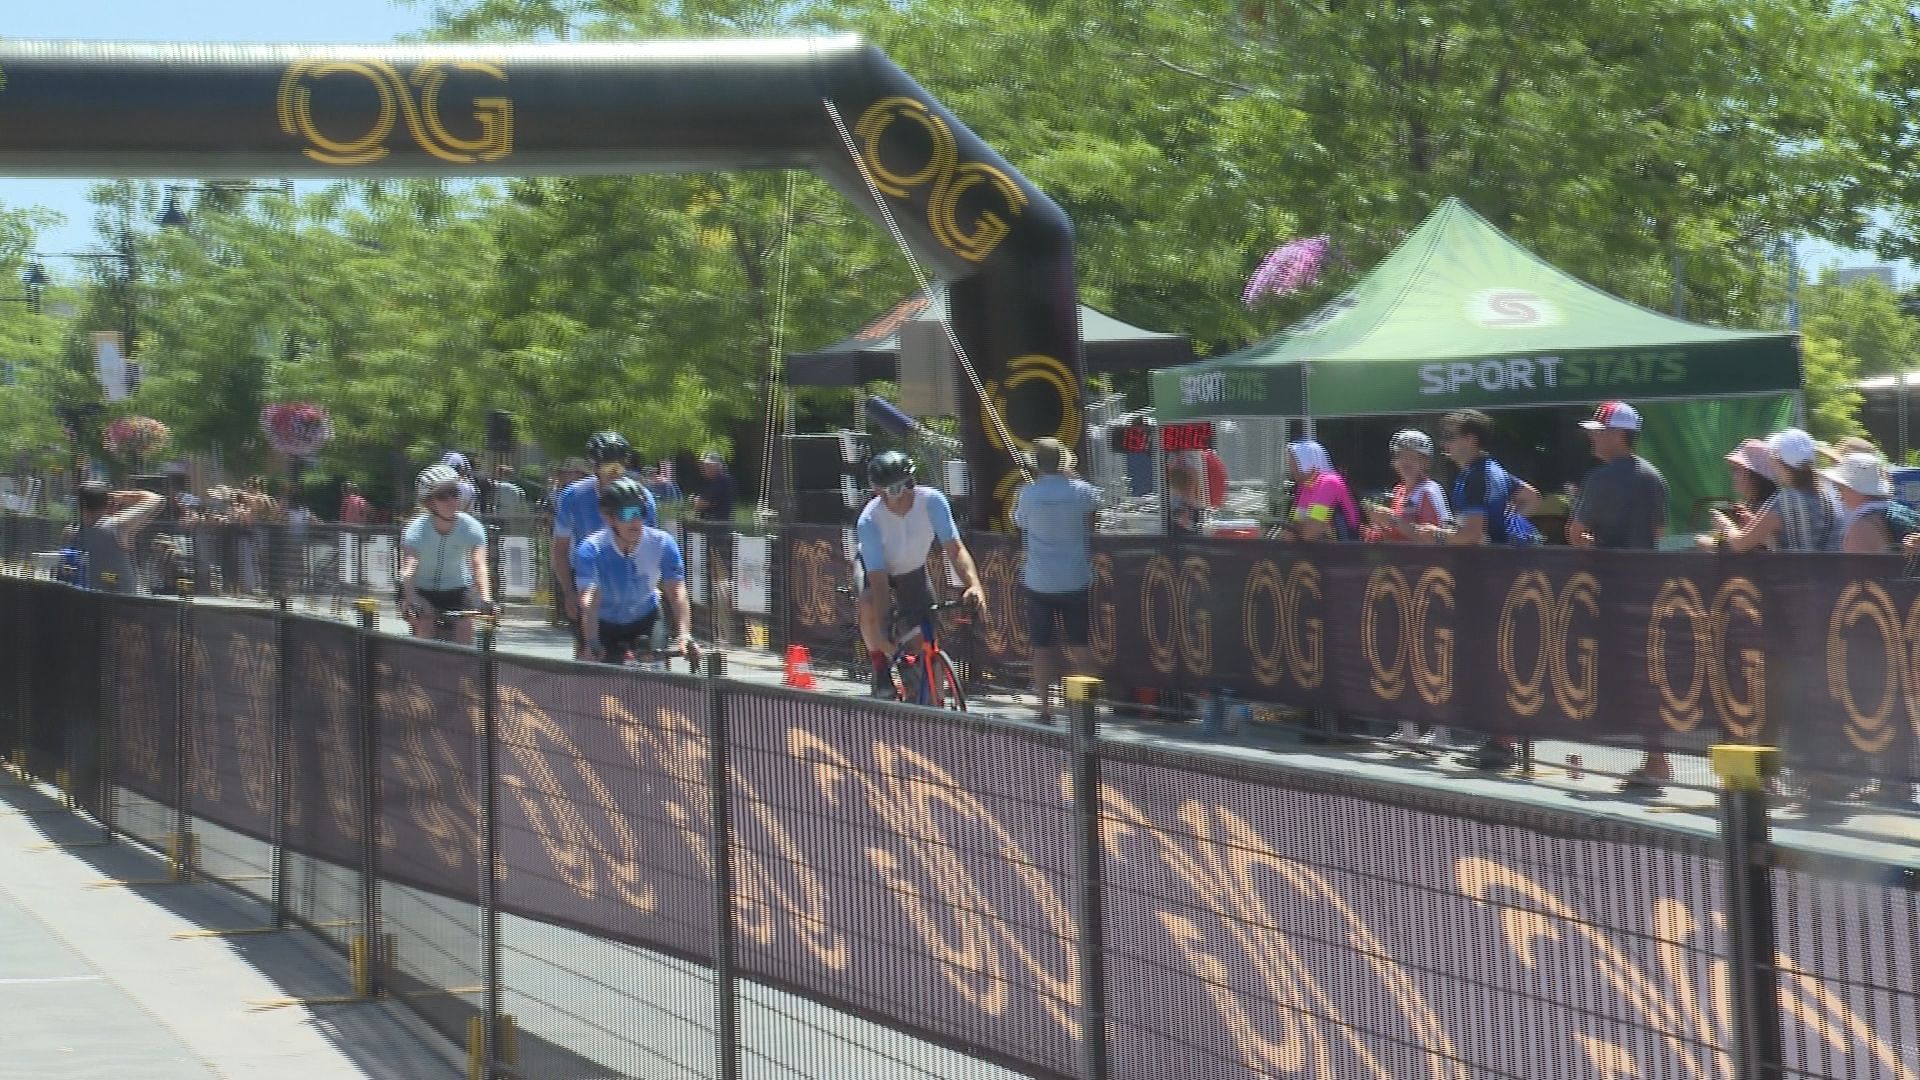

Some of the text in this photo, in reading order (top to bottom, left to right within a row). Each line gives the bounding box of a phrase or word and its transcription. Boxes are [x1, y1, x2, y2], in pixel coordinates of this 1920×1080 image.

[279, 56, 514, 164] OG
[855, 97, 1028, 263] OG
[1142, 555, 1213, 676] OG
[1243, 560, 1323, 688] OG
[1362, 566, 1456, 703] OG
[1497, 570, 1601, 720] OG
[1647, 576, 1766, 738] OG
[1828, 580, 1920, 752] O
